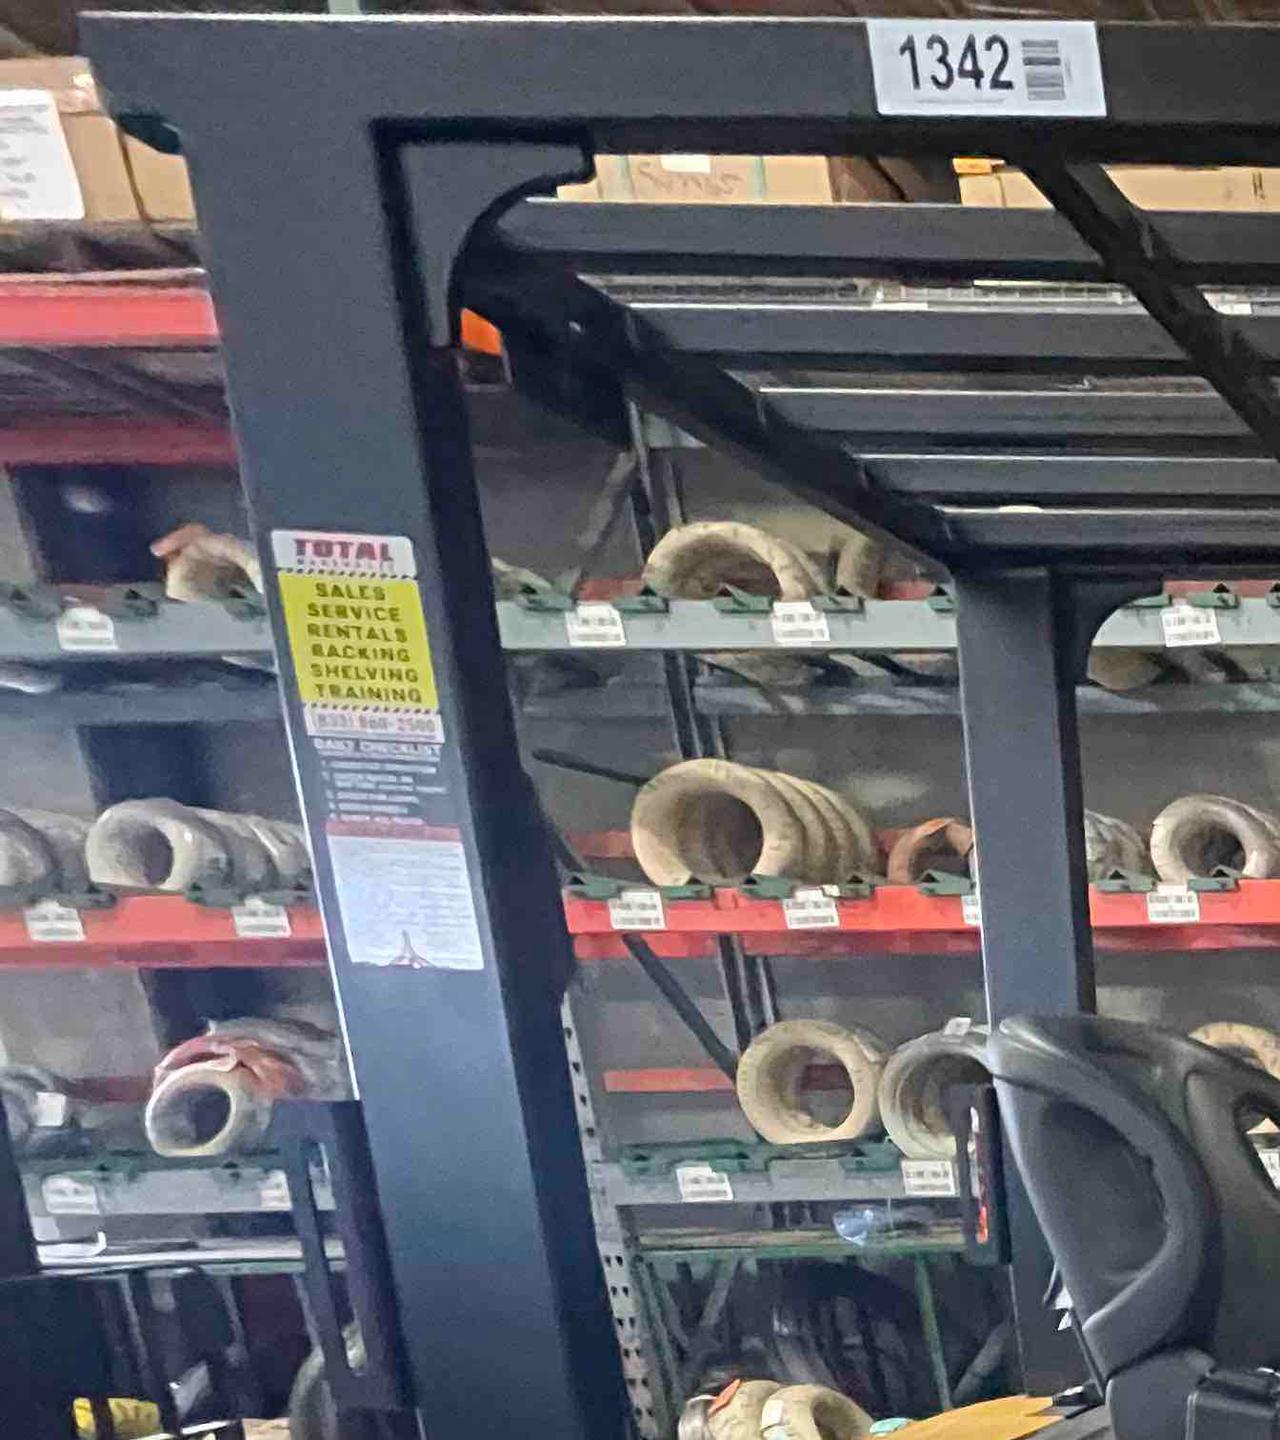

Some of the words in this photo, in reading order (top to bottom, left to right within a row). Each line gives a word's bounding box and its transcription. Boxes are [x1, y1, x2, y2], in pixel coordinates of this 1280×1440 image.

[899, 33, 1015, 91] 1342
[294, 539, 394, 561] TOTAL
[315, 582, 386, 601] SALES
[307, 603, 402, 622] SERVICE
[307, 623, 408, 643] RENTALS
[310, 663, 419, 683] SHELVING
[314, 684, 422, 703] TRAINING
